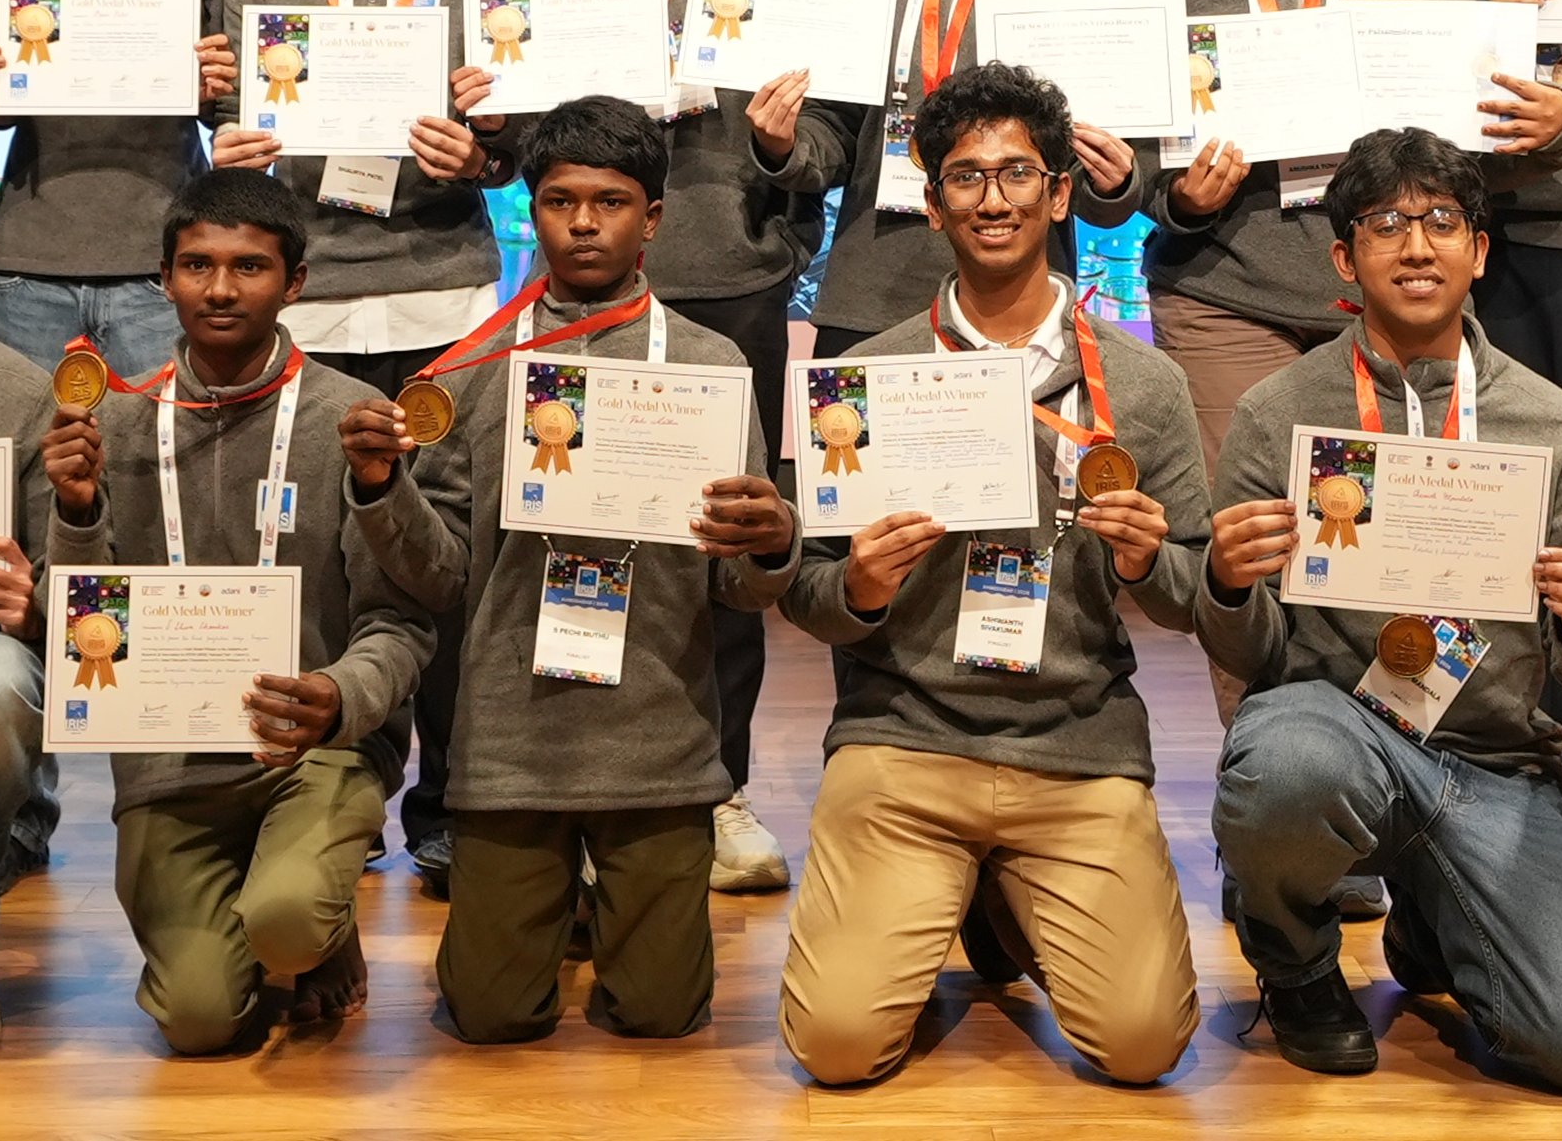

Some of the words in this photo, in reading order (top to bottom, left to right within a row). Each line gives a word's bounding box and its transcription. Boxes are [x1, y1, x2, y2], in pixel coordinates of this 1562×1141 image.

[879, 392, 905, 404] Gold
[943, 389, 988, 401] Winner
[597, 396, 623, 409] Gold
[661, 402, 705, 415] Winner
[1387, 472, 1415, 485] Gold
[1419, 475, 1454, 488] Medal
[1457, 478, 1504, 492] Winner
[142, 605, 169, 617] Gold
[172, 605, 206, 617] Medal
[209, 605, 255, 617] Winner
